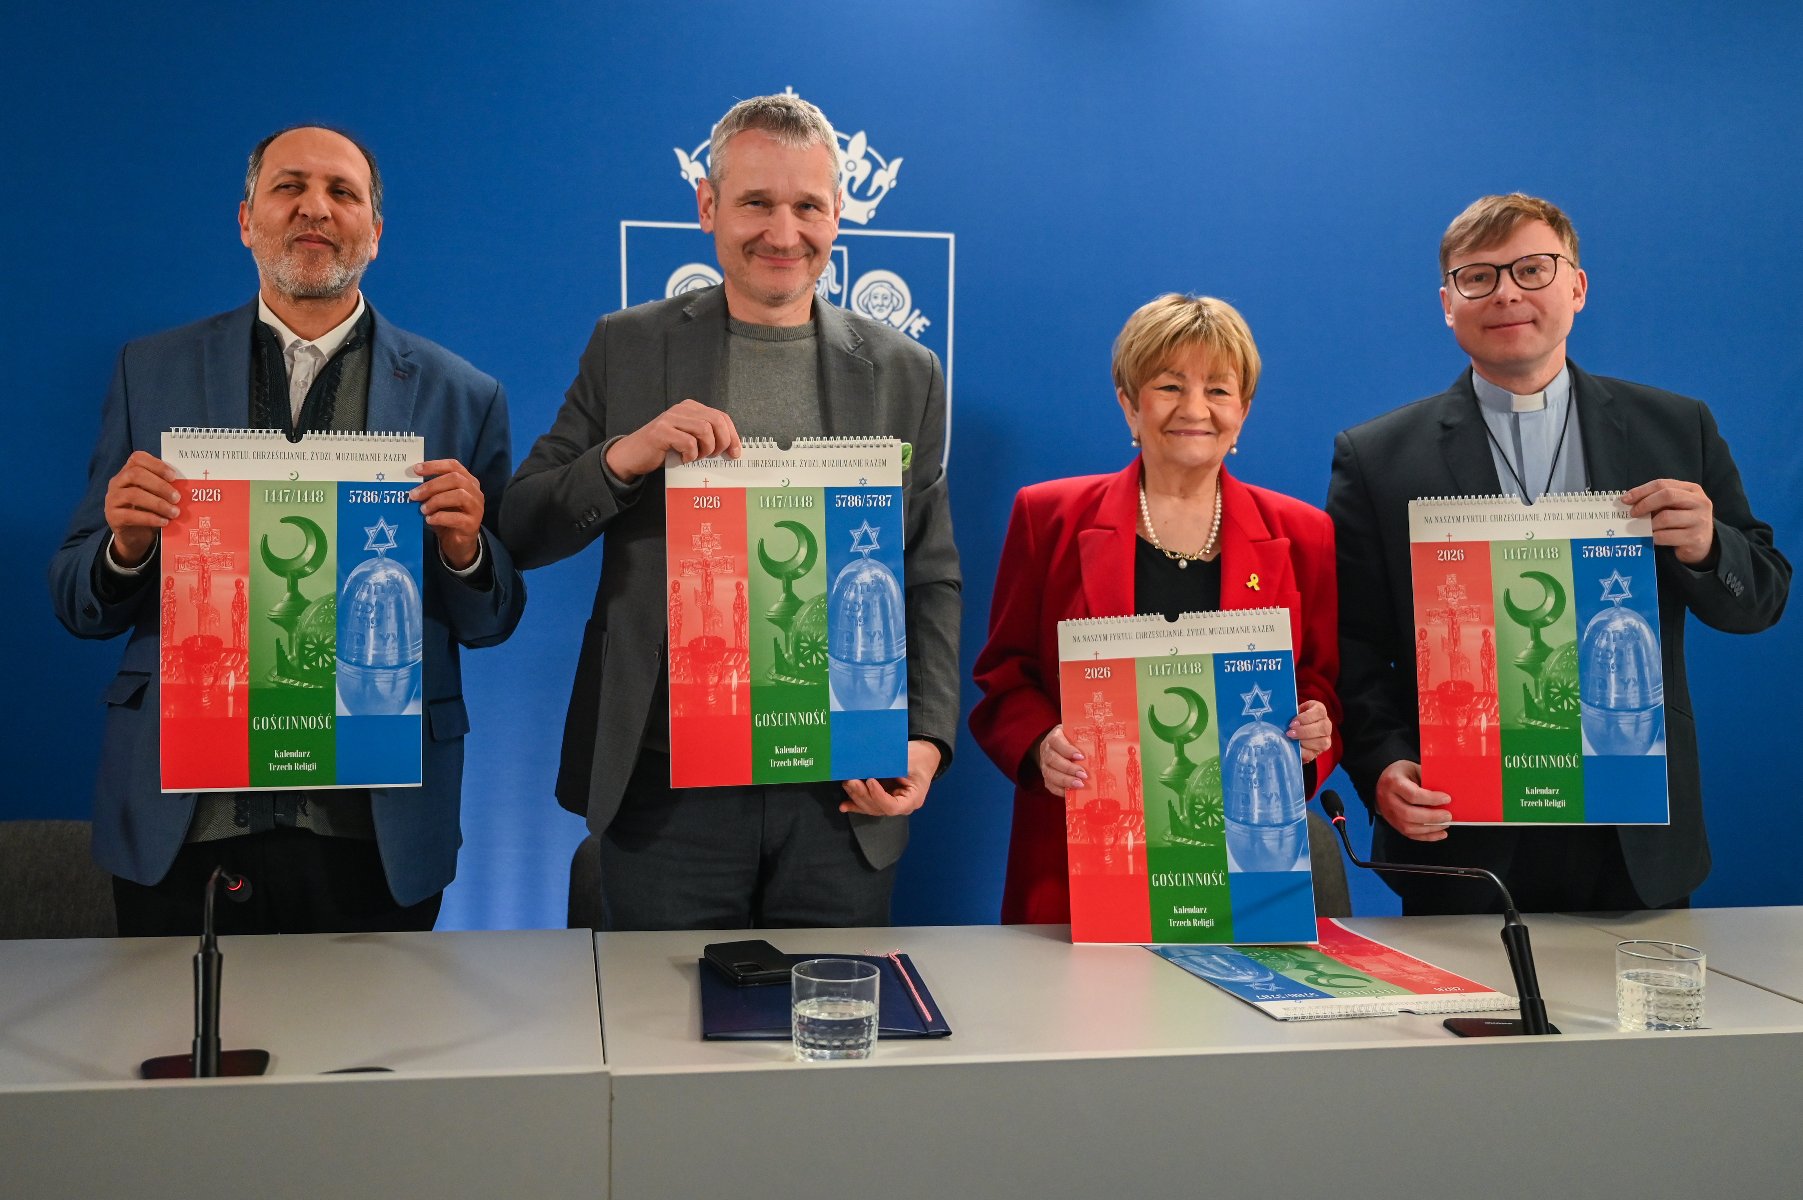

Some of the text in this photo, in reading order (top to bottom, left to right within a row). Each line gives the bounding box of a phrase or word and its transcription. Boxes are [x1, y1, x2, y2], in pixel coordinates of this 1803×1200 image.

[178, 449, 189, 460] NA
[190, 449, 220, 460] NASZYM
[383, 453, 407, 462] RAZEM
[191, 488, 221, 502] 2026
[264, 489, 324, 503] 1447/1448
[348, 489, 411, 504] 5786/5787
[693, 495, 721, 509] 2026
[759, 495, 813, 508] 1447/1448
[835, 494, 892, 508] 5786/5787
[1424, 515, 1433, 524] NA
[1434, 515, 1461, 524] NASZYM
[1611, 510, 1632, 519] RAZE
[1437, 549, 1464, 561] 2026
[1503, 547, 1559, 560] 1447/1448
[1582, 545, 1643, 559] 5786/5787
[1148, 661, 1202, 677] 1447/1448
[1224, 658, 1282, 673] 5786/5787
[1084, 666, 1111, 680] 2026
[253, 713, 332, 730] GOŚCINNOŚĆ
[755, 709, 827, 727] GOŚCINNOŚĆ
[274, 749, 311, 758] Kalendarz
[775, 745, 807, 754] Kalendarz
[269, 762, 316, 772] Trzech Religii
[770, 758, 814, 767] Trzech Religii
[1505, 753, 1579, 768] GOŚCINNOŚĆ
[1525, 787, 1559, 795] Kalendarz
[1520, 798, 1566, 808] Trzech Religii
[1152, 870, 1226, 887] GOŚCINNOŚĆ
[1173, 905, 1207, 914] Kalendarz
[1169, 917, 1214, 928] Trzech Religii
